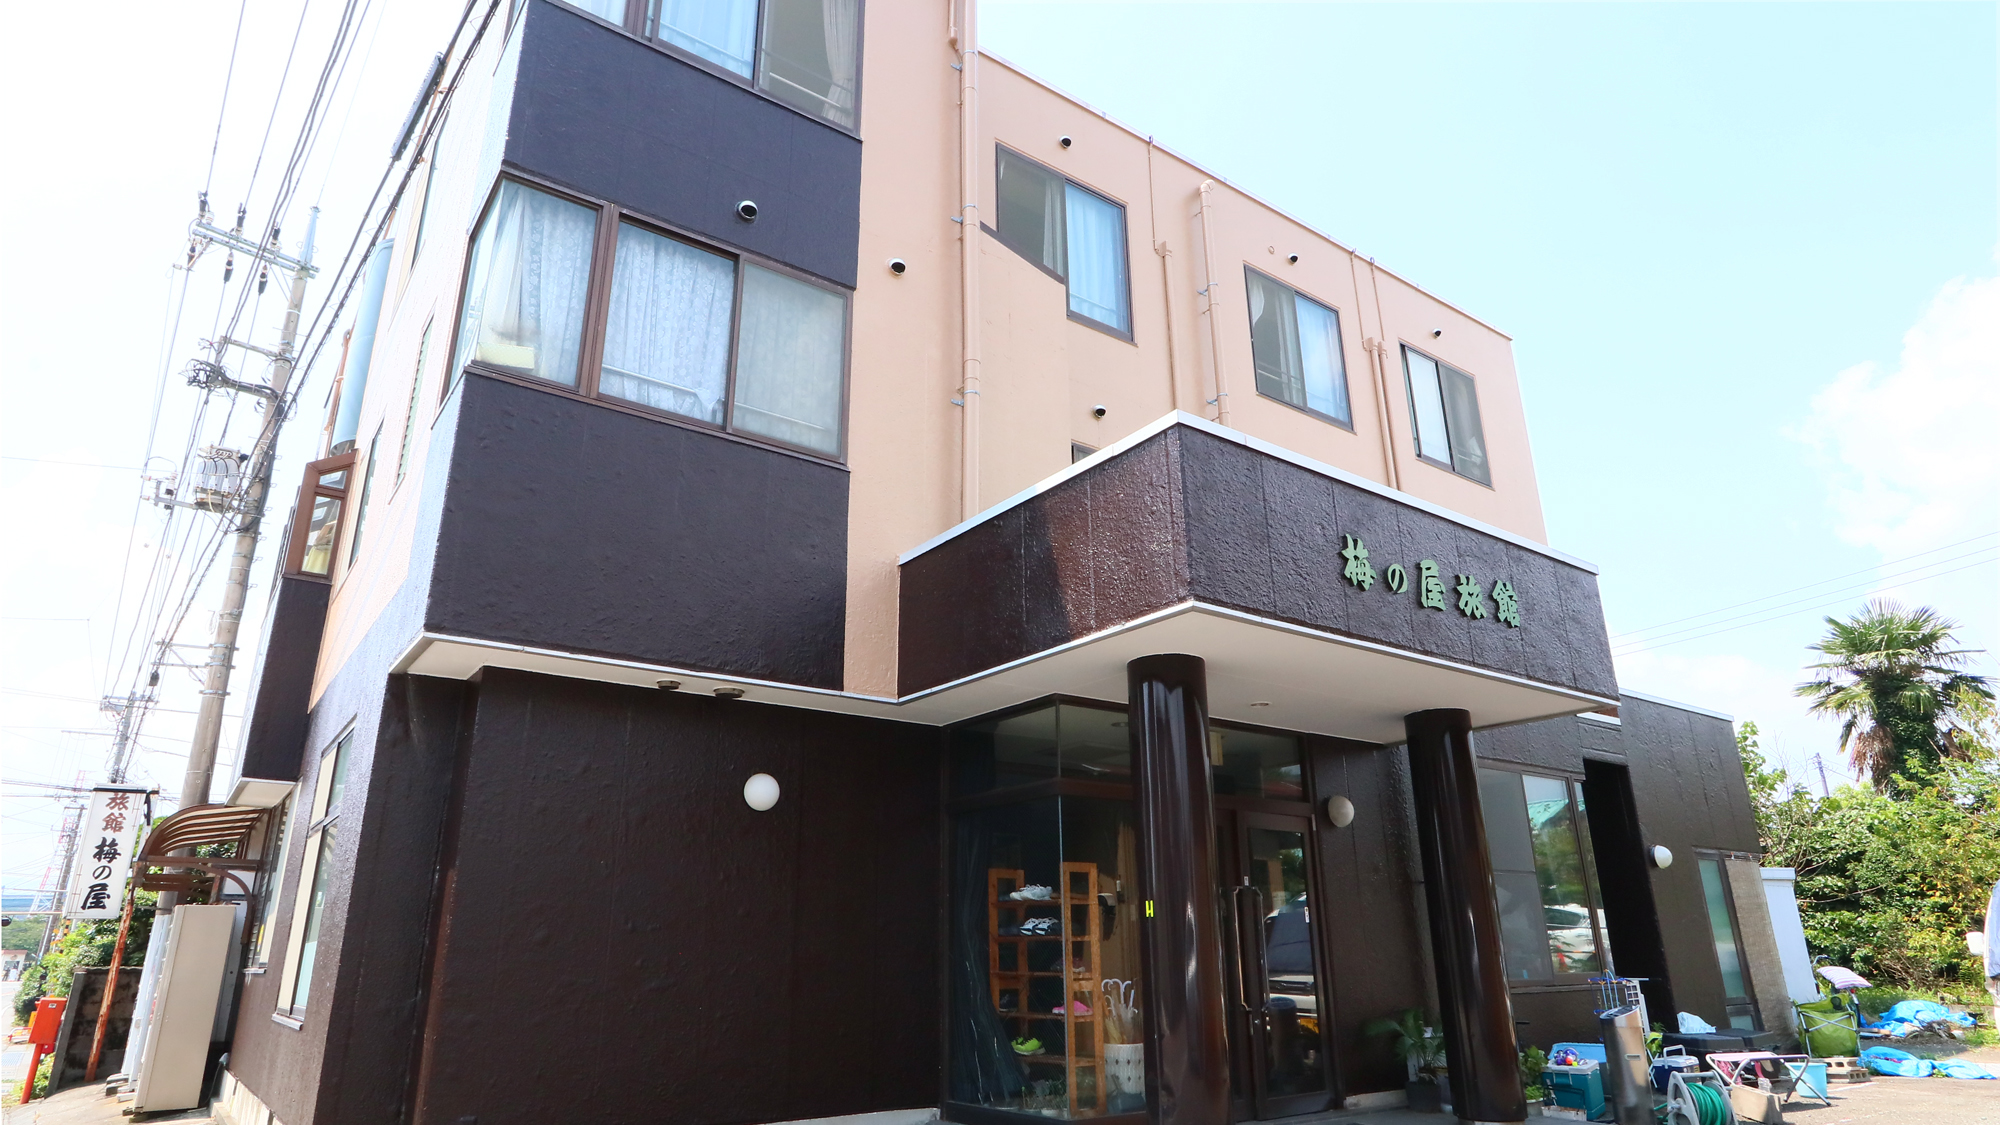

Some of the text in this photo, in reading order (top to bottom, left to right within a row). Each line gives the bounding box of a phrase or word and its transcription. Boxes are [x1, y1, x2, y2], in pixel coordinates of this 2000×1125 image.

[1341, 533, 1520, 628] 梅の屋旅館
